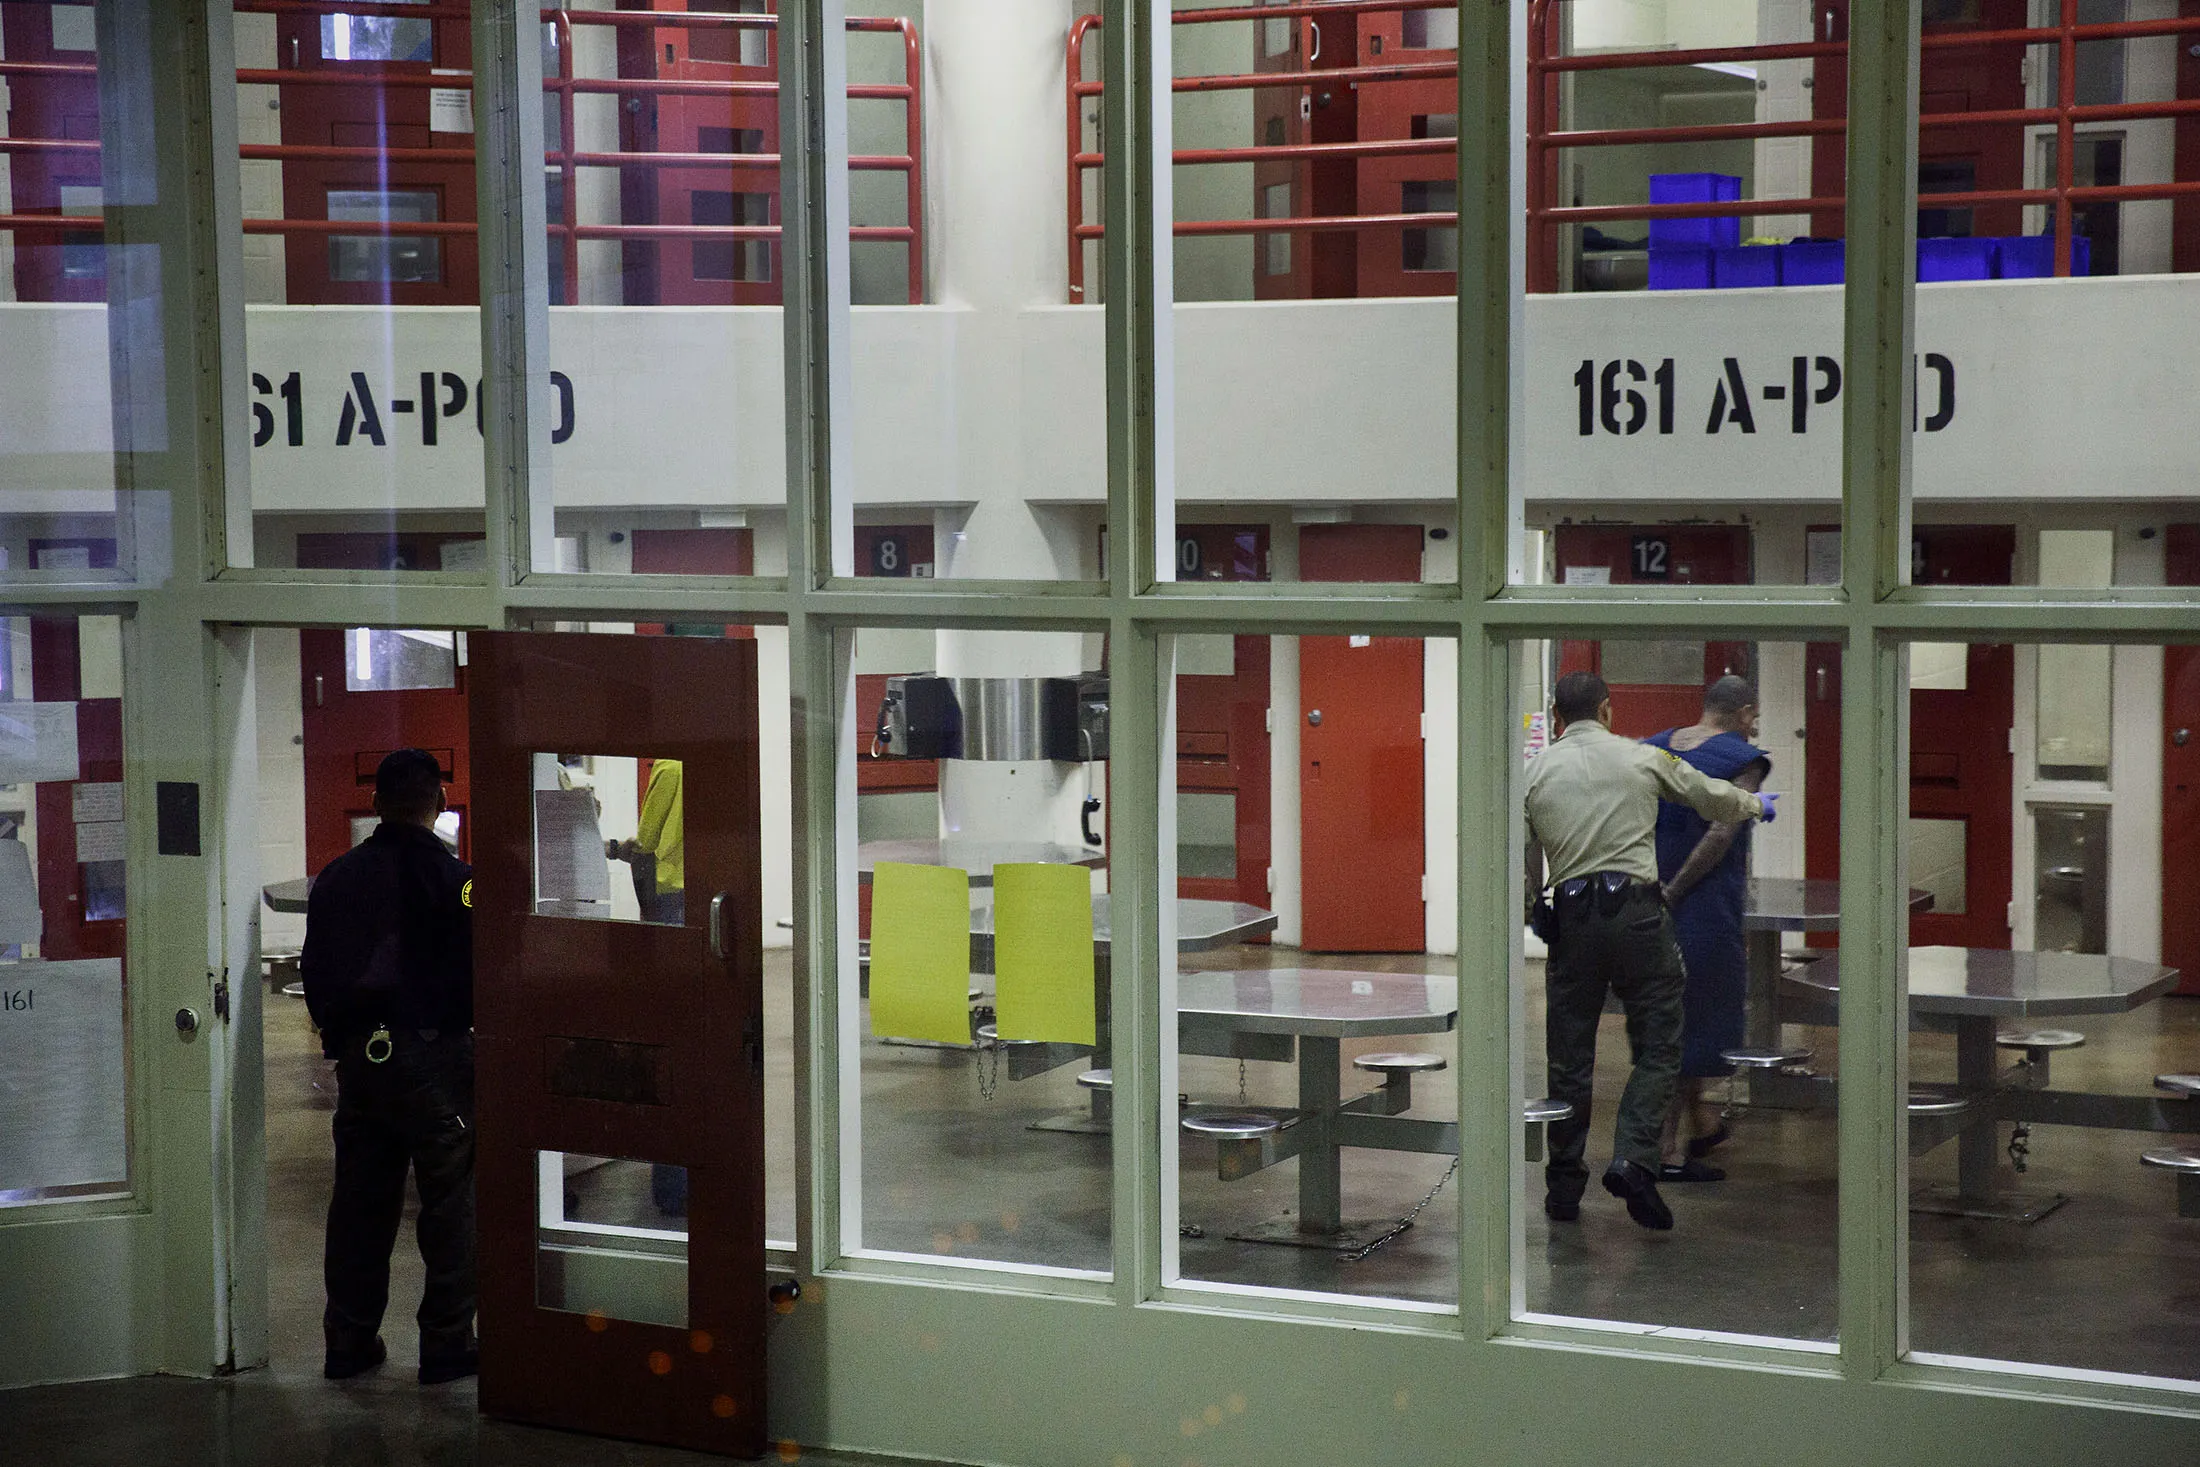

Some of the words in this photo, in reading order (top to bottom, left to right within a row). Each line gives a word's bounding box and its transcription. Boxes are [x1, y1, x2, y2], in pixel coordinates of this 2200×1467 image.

[335, 371, 575, 446] A-PD
[1573, 358, 1675, 435] 161
[1706, 353, 1955, 434] A-PD
[881, 540, 898, 570] 8
[1634, 540, 1667, 573] 12
[4, 989, 33, 1011] 161
